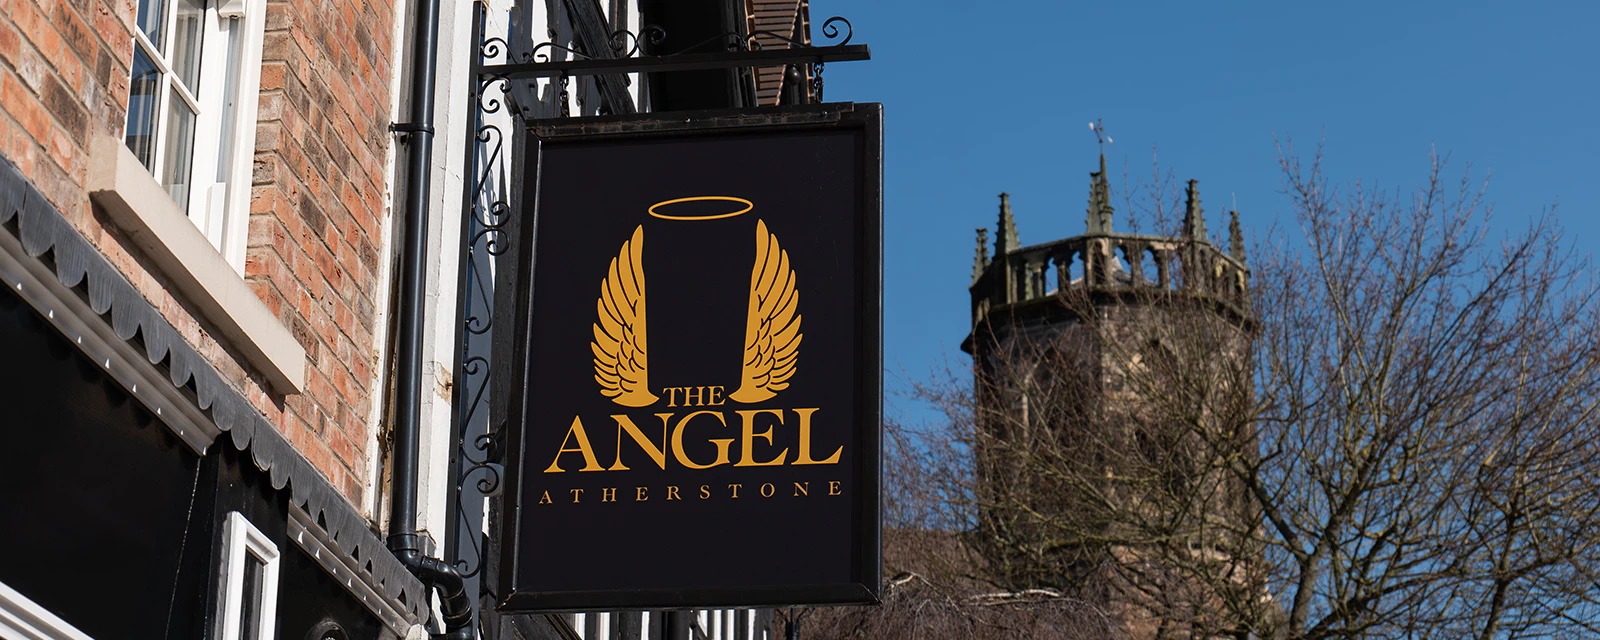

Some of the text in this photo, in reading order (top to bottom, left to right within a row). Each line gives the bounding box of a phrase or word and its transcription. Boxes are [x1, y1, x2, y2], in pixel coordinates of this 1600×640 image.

[663, 385, 726, 408] THE
[543, 407, 845, 474] ANGEL
[538, 481, 842, 505] ATHERSTONE
